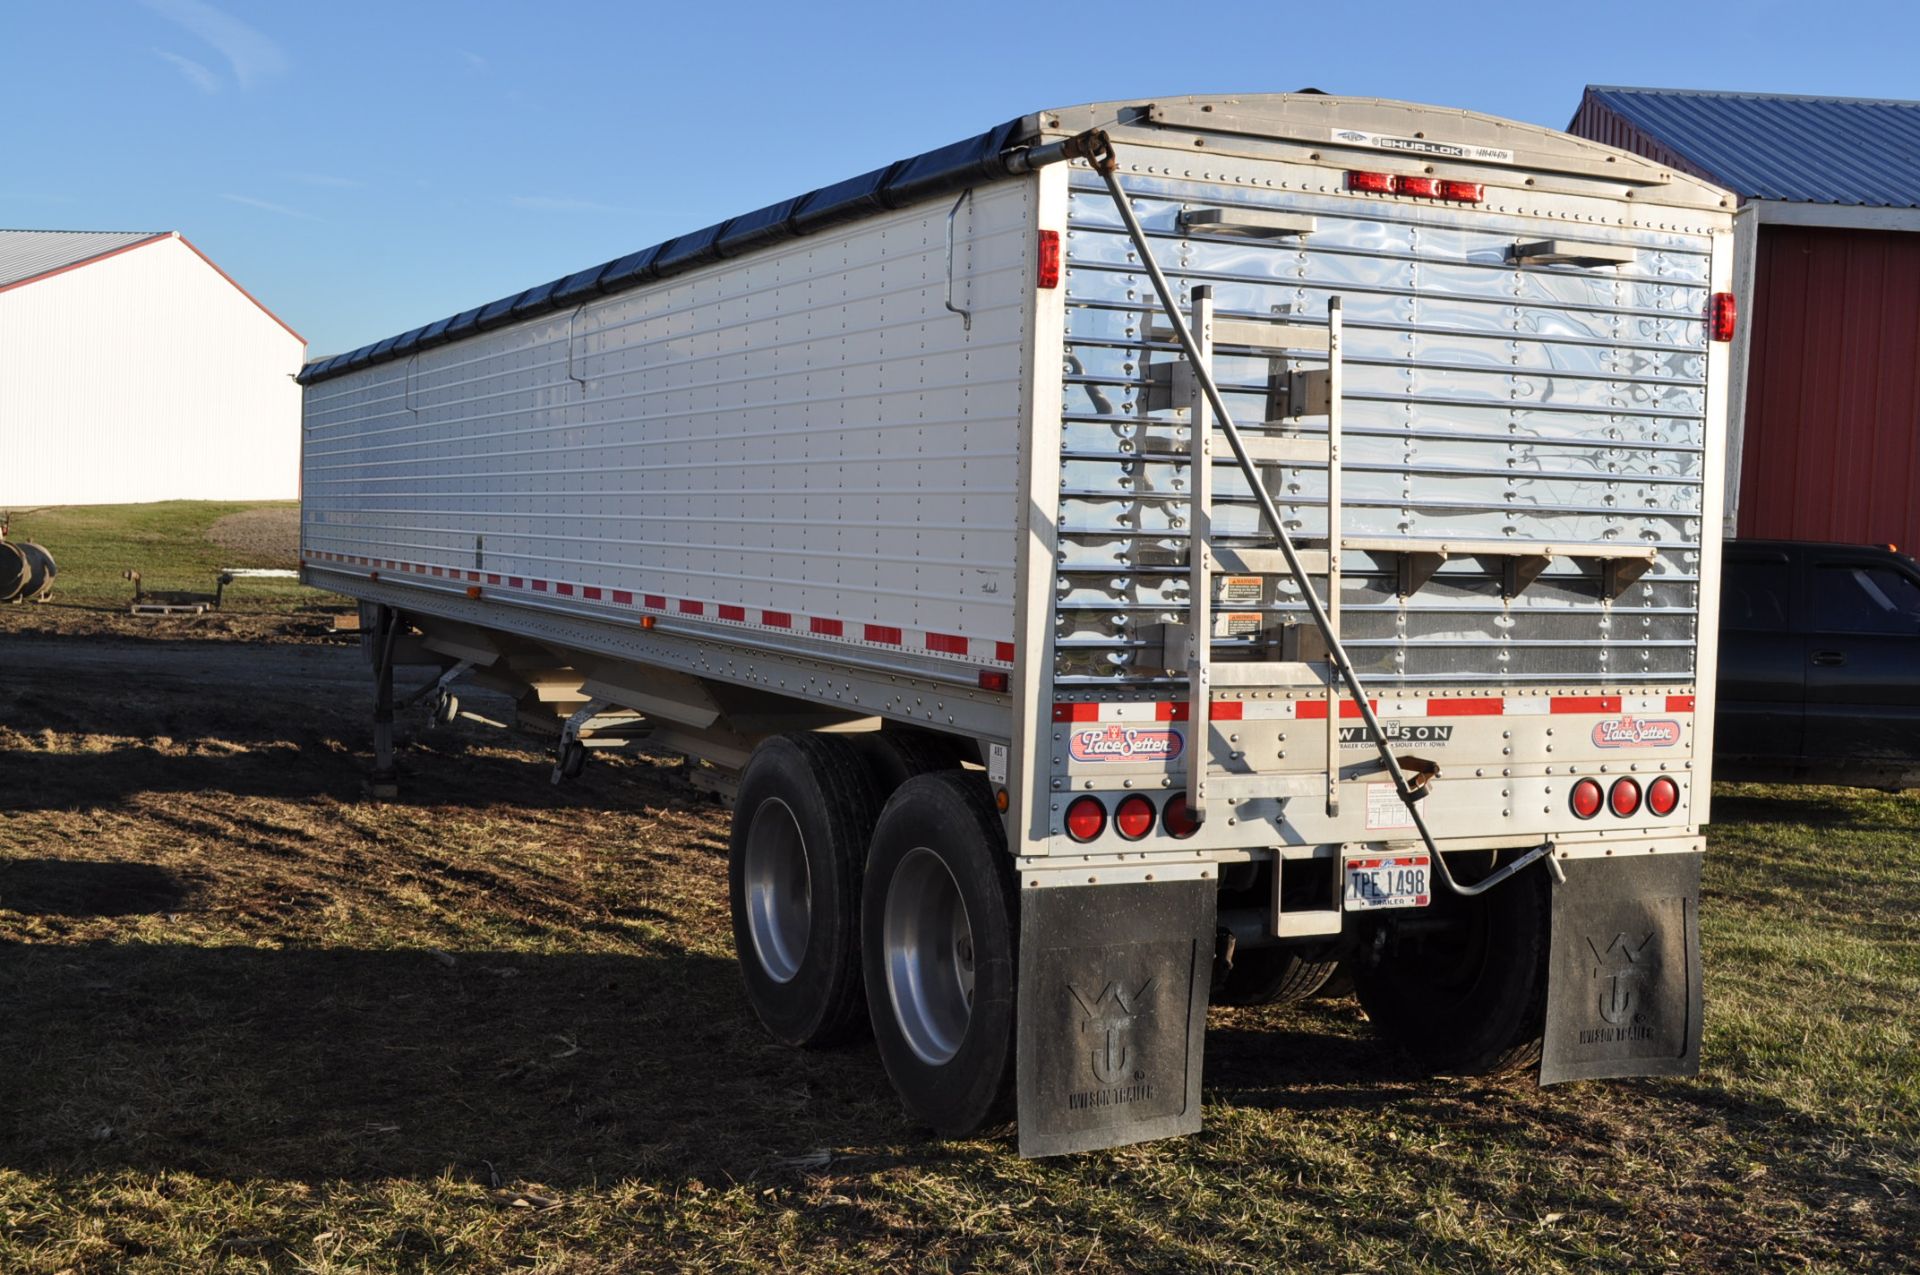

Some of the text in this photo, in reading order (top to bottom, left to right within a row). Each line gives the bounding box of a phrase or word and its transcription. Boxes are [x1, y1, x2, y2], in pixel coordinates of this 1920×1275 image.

[1380, 138, 1462, 156] SHUR-LOK
[1082, 729, 1171, 757] PaceSetter
[1339, 726, 1448, 741] WISON
[1352, 869, 1425, 898] TPE 1498
